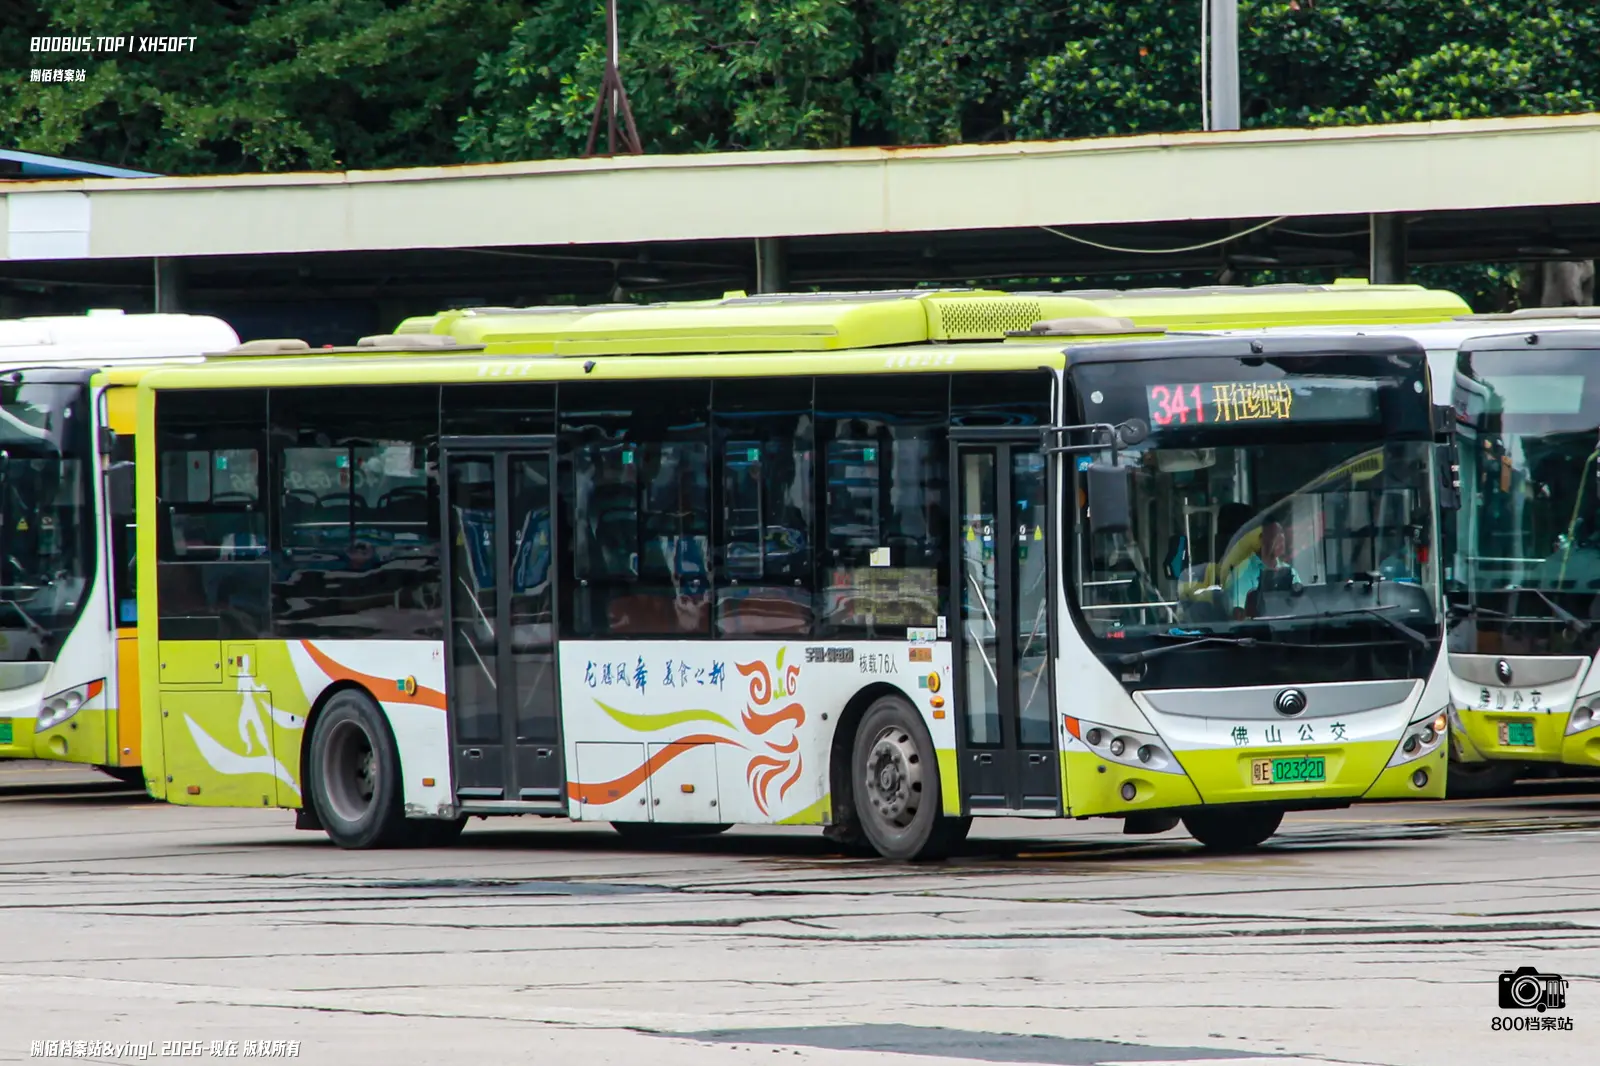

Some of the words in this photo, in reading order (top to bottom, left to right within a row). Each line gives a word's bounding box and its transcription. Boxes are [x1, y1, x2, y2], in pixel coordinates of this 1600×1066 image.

[1151, 383, 1205, 425] 341
[584, 655, 649, 695] 龙腾凤舞
[662, 659, 726, 692] 美食之都
[859, 653, 899, 674] 核载76人
[1230, 721, 1349, 746] 佛山公交
